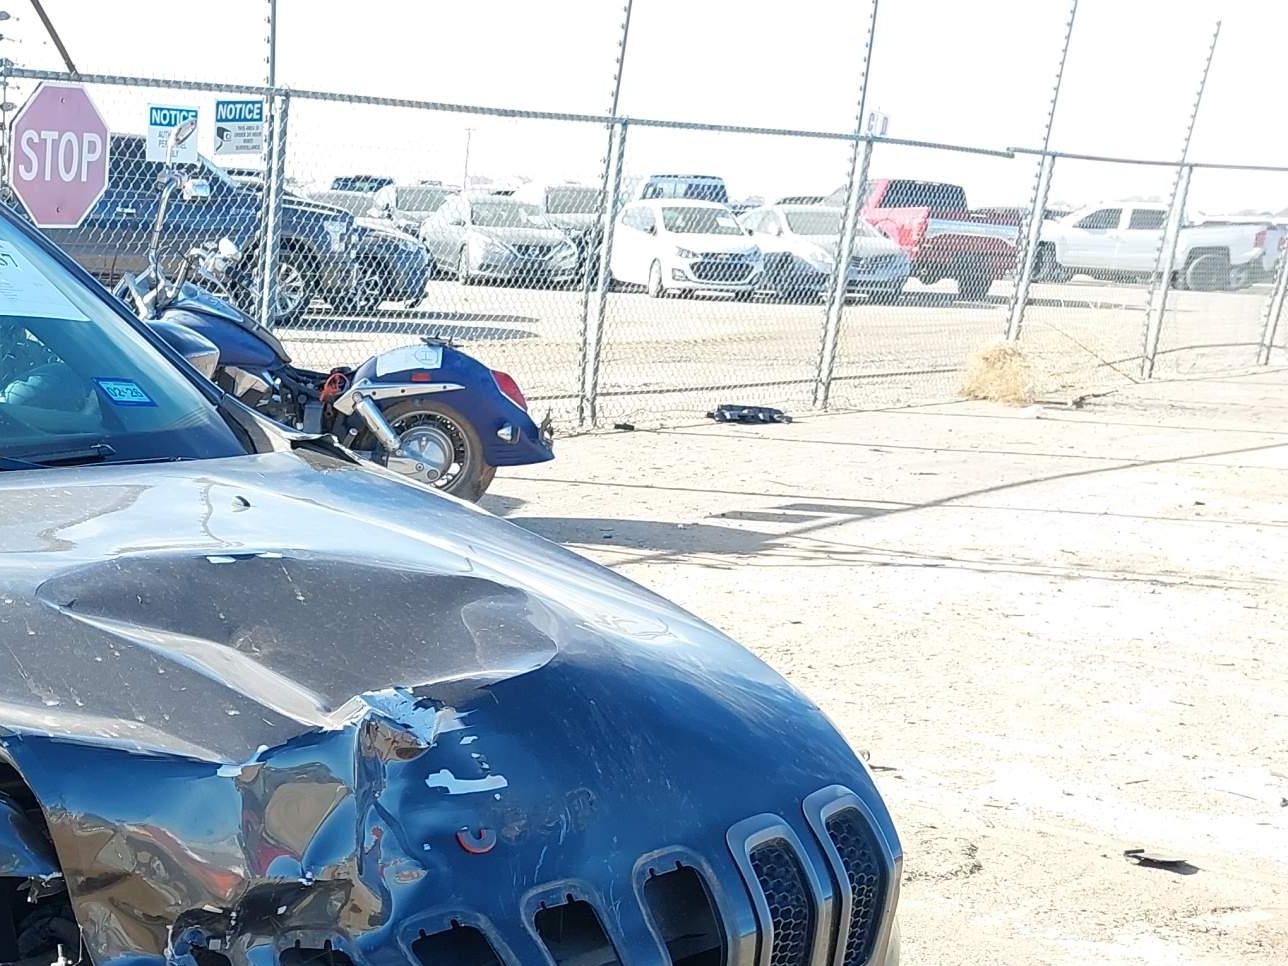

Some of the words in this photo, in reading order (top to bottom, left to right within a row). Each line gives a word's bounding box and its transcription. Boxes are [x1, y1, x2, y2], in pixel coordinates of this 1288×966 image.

[151, 108, 196, 125] NOTICE
[217, 103, 262, 120] NOTICE
[18, 129, 102, 182] STOP
